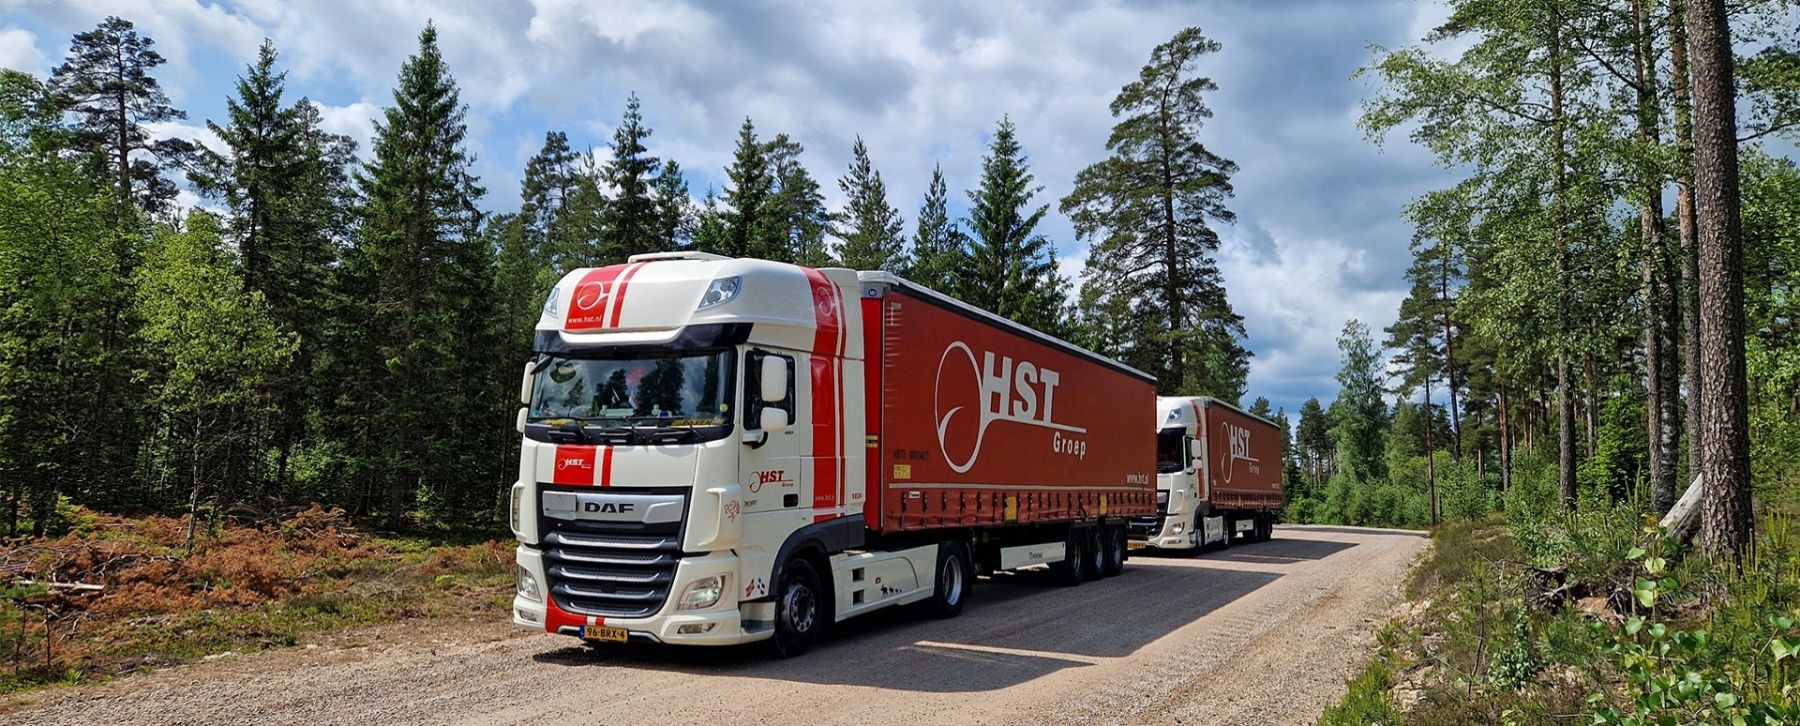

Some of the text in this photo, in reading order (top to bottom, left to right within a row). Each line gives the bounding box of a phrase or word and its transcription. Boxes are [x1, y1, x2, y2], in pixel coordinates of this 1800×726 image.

[982, 351, 1060, 423] HST
[1053, 431, 1086, 461] Groep
[1230, 425, 1250, 457] HST
[760, 470, 784, 482] HST
[584, 502, 634, 513] DAF
[586, 627, 625, 638] 96-BRX-4
